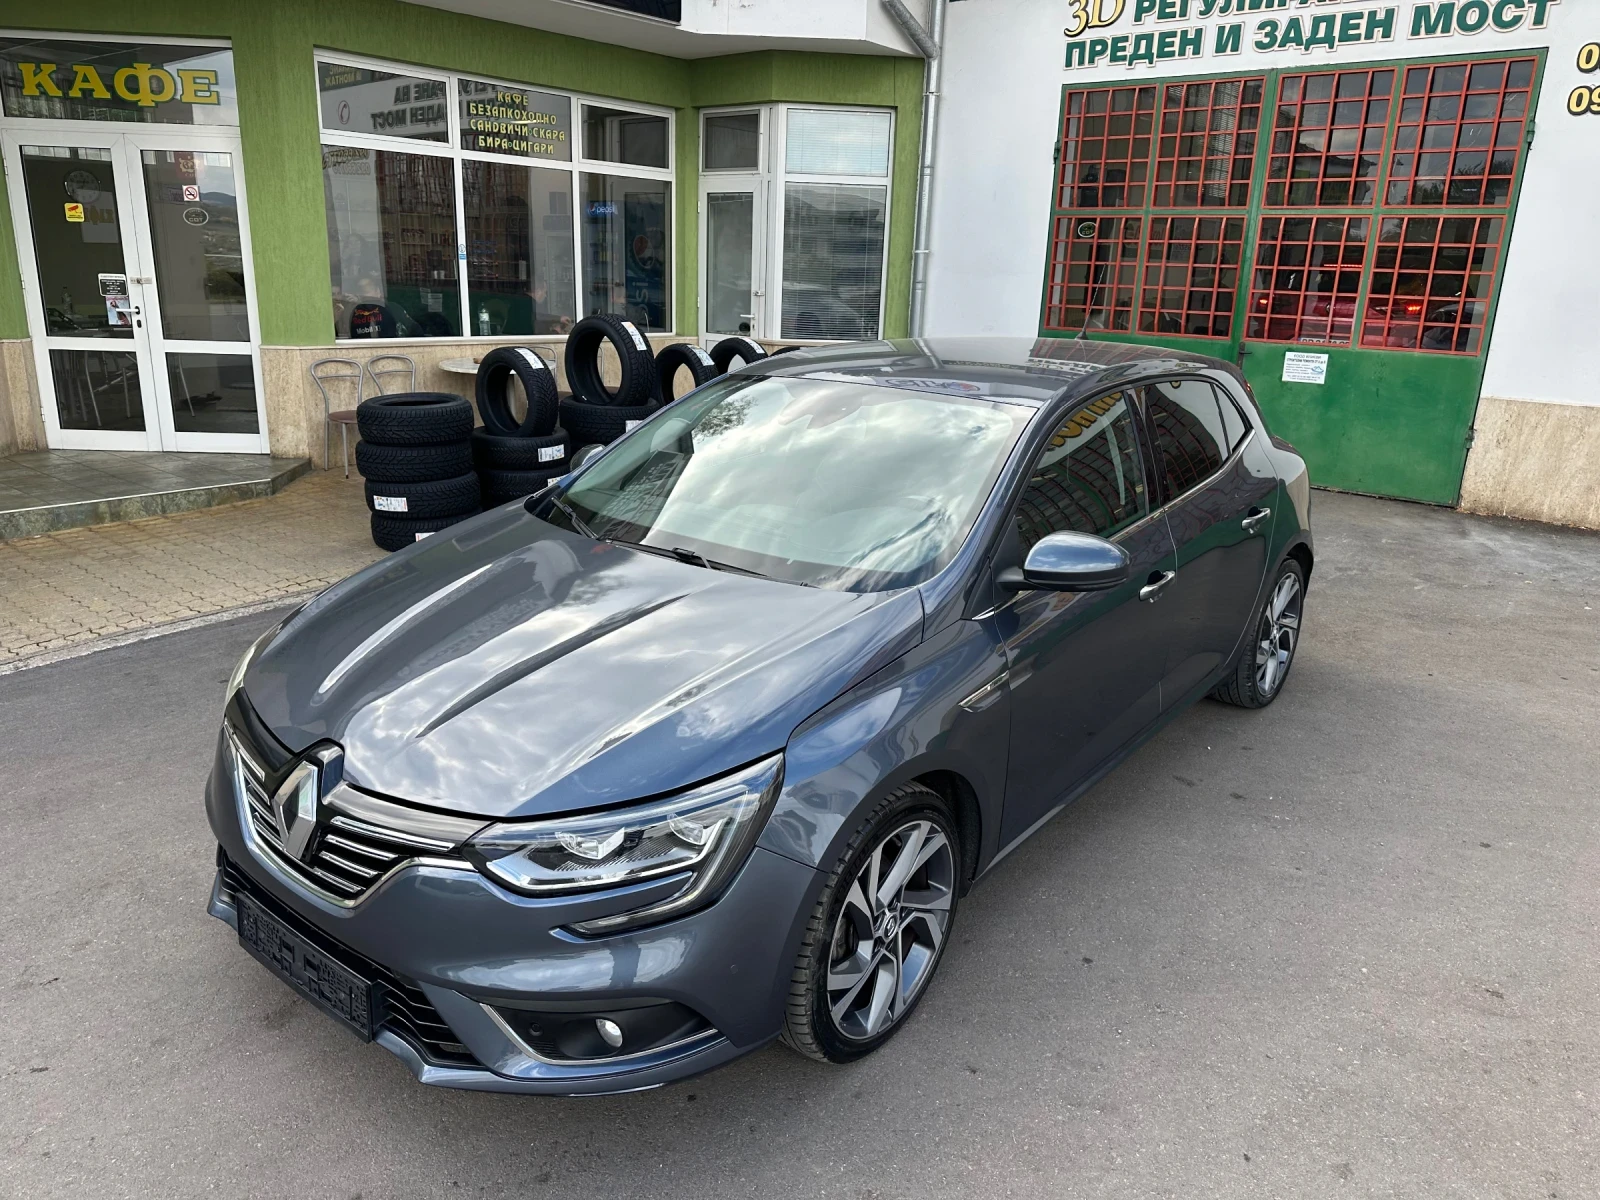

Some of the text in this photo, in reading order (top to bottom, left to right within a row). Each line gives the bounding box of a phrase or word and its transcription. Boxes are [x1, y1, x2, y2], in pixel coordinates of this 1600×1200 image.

[1064, 0, 1126, 37] 3D
[1064, 0, 1553, 68] ПРЕДЕН И ЗАДЕН МОСТ
[17, 62, 220, 107] КАФЕ
[497, 90, 529, 106] КАФЕ
[478, 135, 554, 154] БИРА ЦИГАРИ
[532, 127, 565, 141] СКАРА
